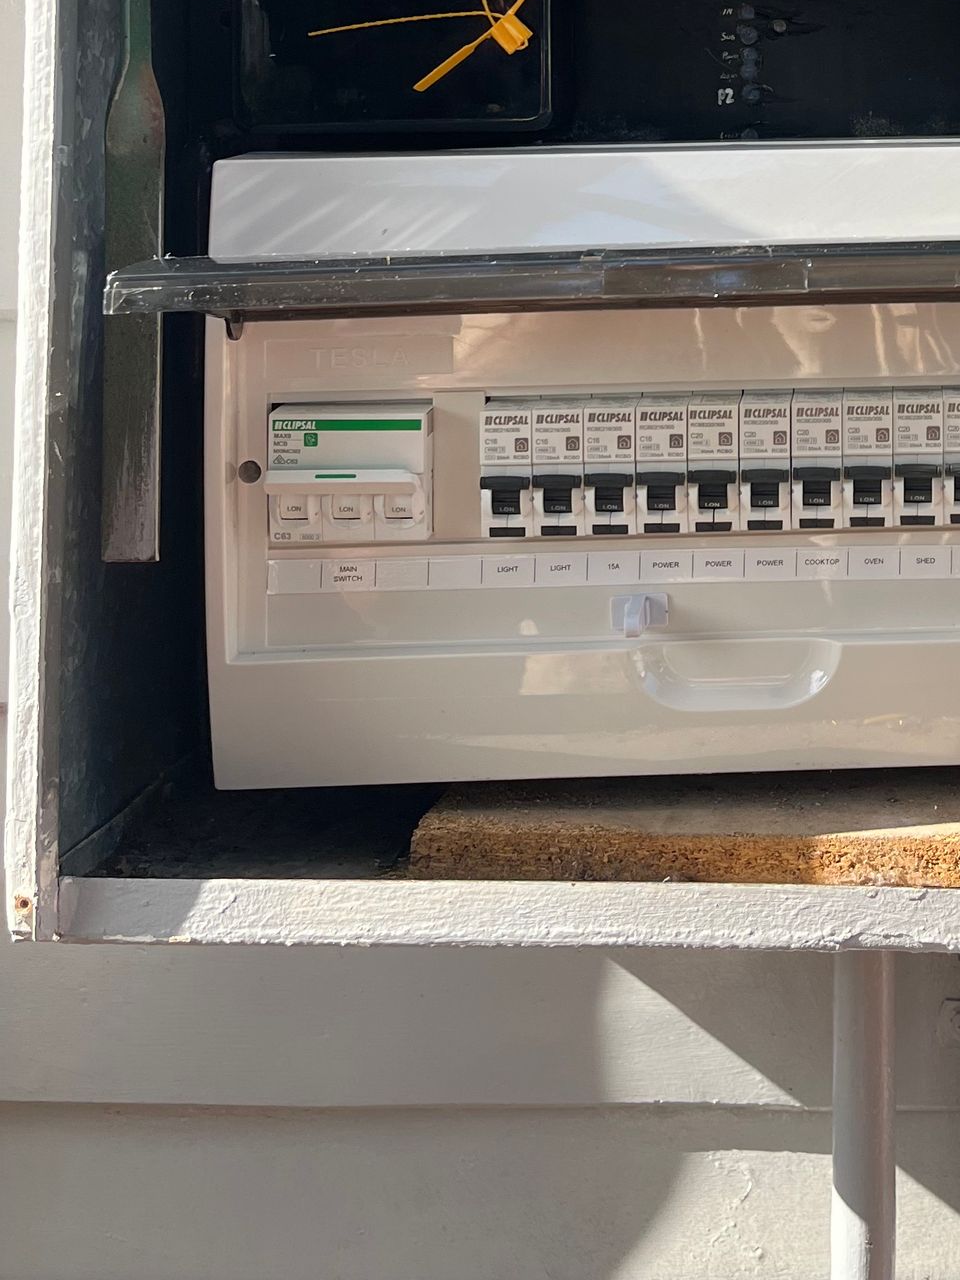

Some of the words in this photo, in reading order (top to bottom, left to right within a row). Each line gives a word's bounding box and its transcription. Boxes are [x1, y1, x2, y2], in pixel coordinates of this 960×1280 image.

[718, 88, 734, 105] P2
[751, 409, 787, 418] CLIPSAL
[804, 408, 839, 417] CLIPSAL
[854, 406, 889, 415] CLIPSAL
[906, 404, 940, 414] CLIPSAL
[596, 413, 631, 422] CLIPSAL
[649, 412, 683, 421] CLIPSAL
[698, 410, 732, 419] CLIPSAL
[493, 416, 528, 425] CLIPSAL
[545, 415, 580, 424] CLIPSAL
[283, 421, 316, 429] CLIPSAL
